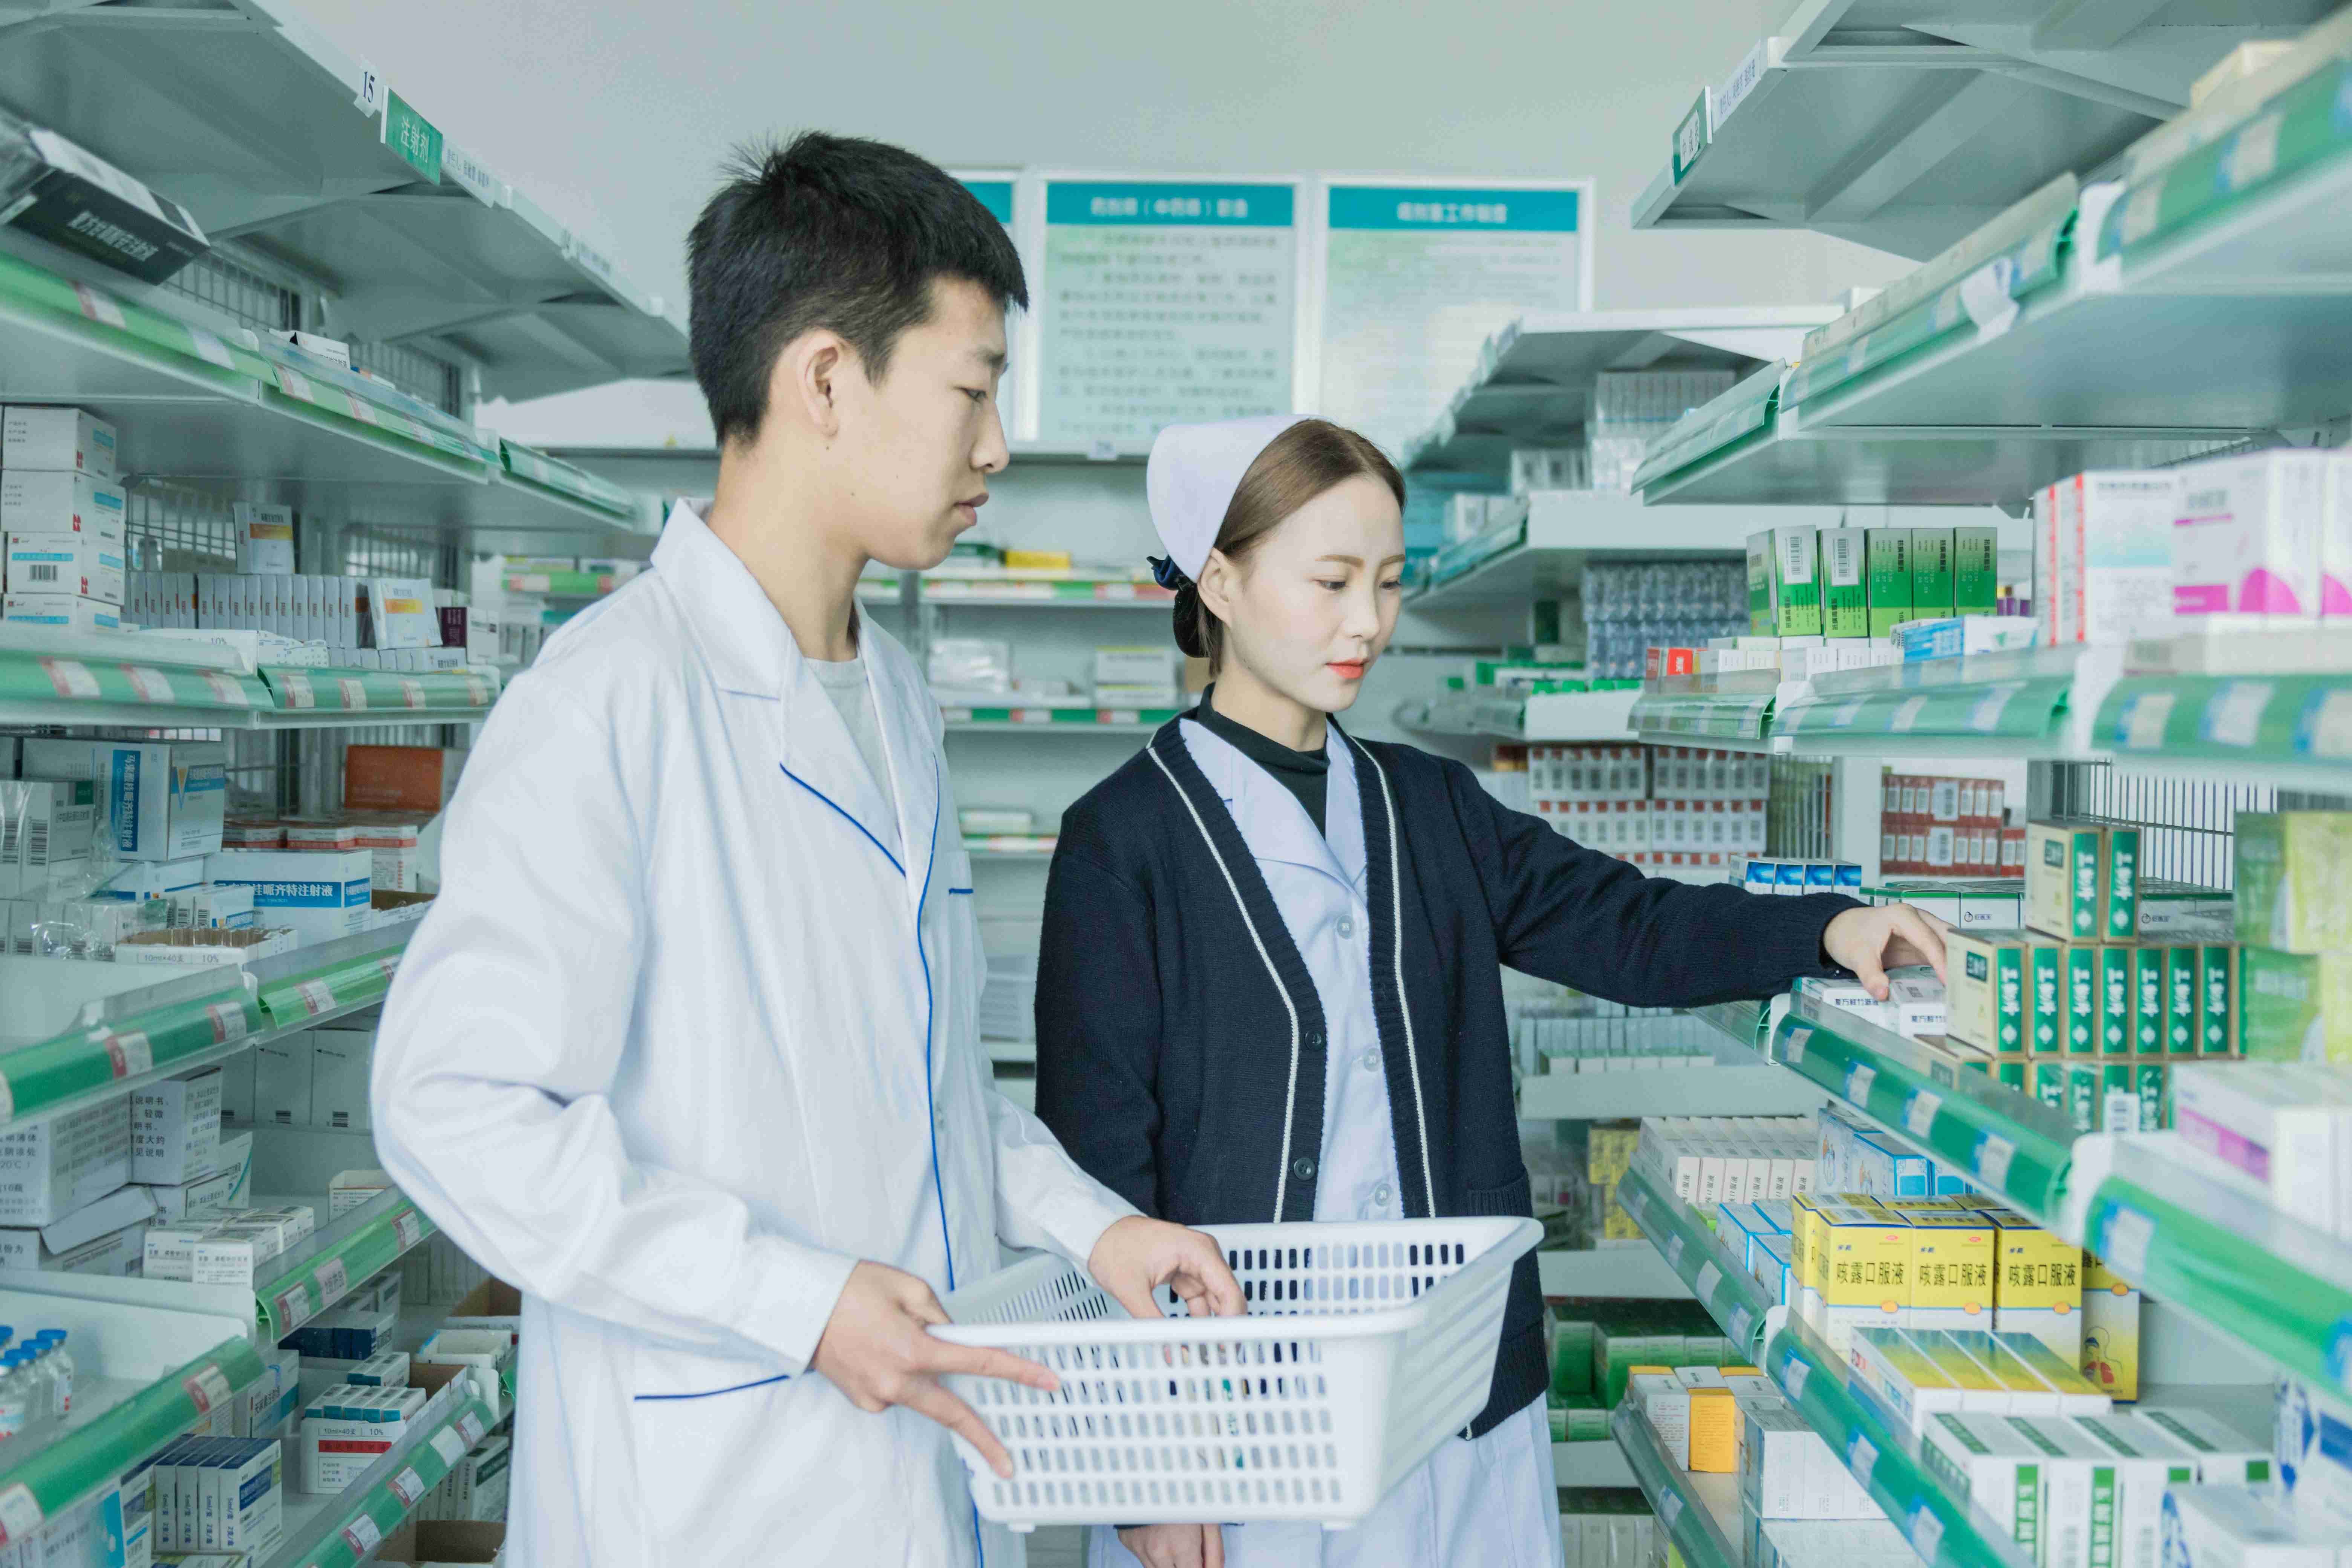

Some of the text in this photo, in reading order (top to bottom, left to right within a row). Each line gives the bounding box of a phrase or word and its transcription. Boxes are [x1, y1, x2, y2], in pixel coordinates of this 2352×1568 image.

[363, 72, 375, 103] 15
[401, 116, 429, 164] 注射剂
[130, 1135, 165, 1145] 度大约
[130, 1147, 164, 1158] 见说明
[1753, 1176, 1762, 1201] 口服液
[1837, 1261, 1905, 1285] 咳露口服液
[1919, 1263, 1987, 1286] 咳露口服液
[2008, 1263, 2076, 1287] 咳露口服液
